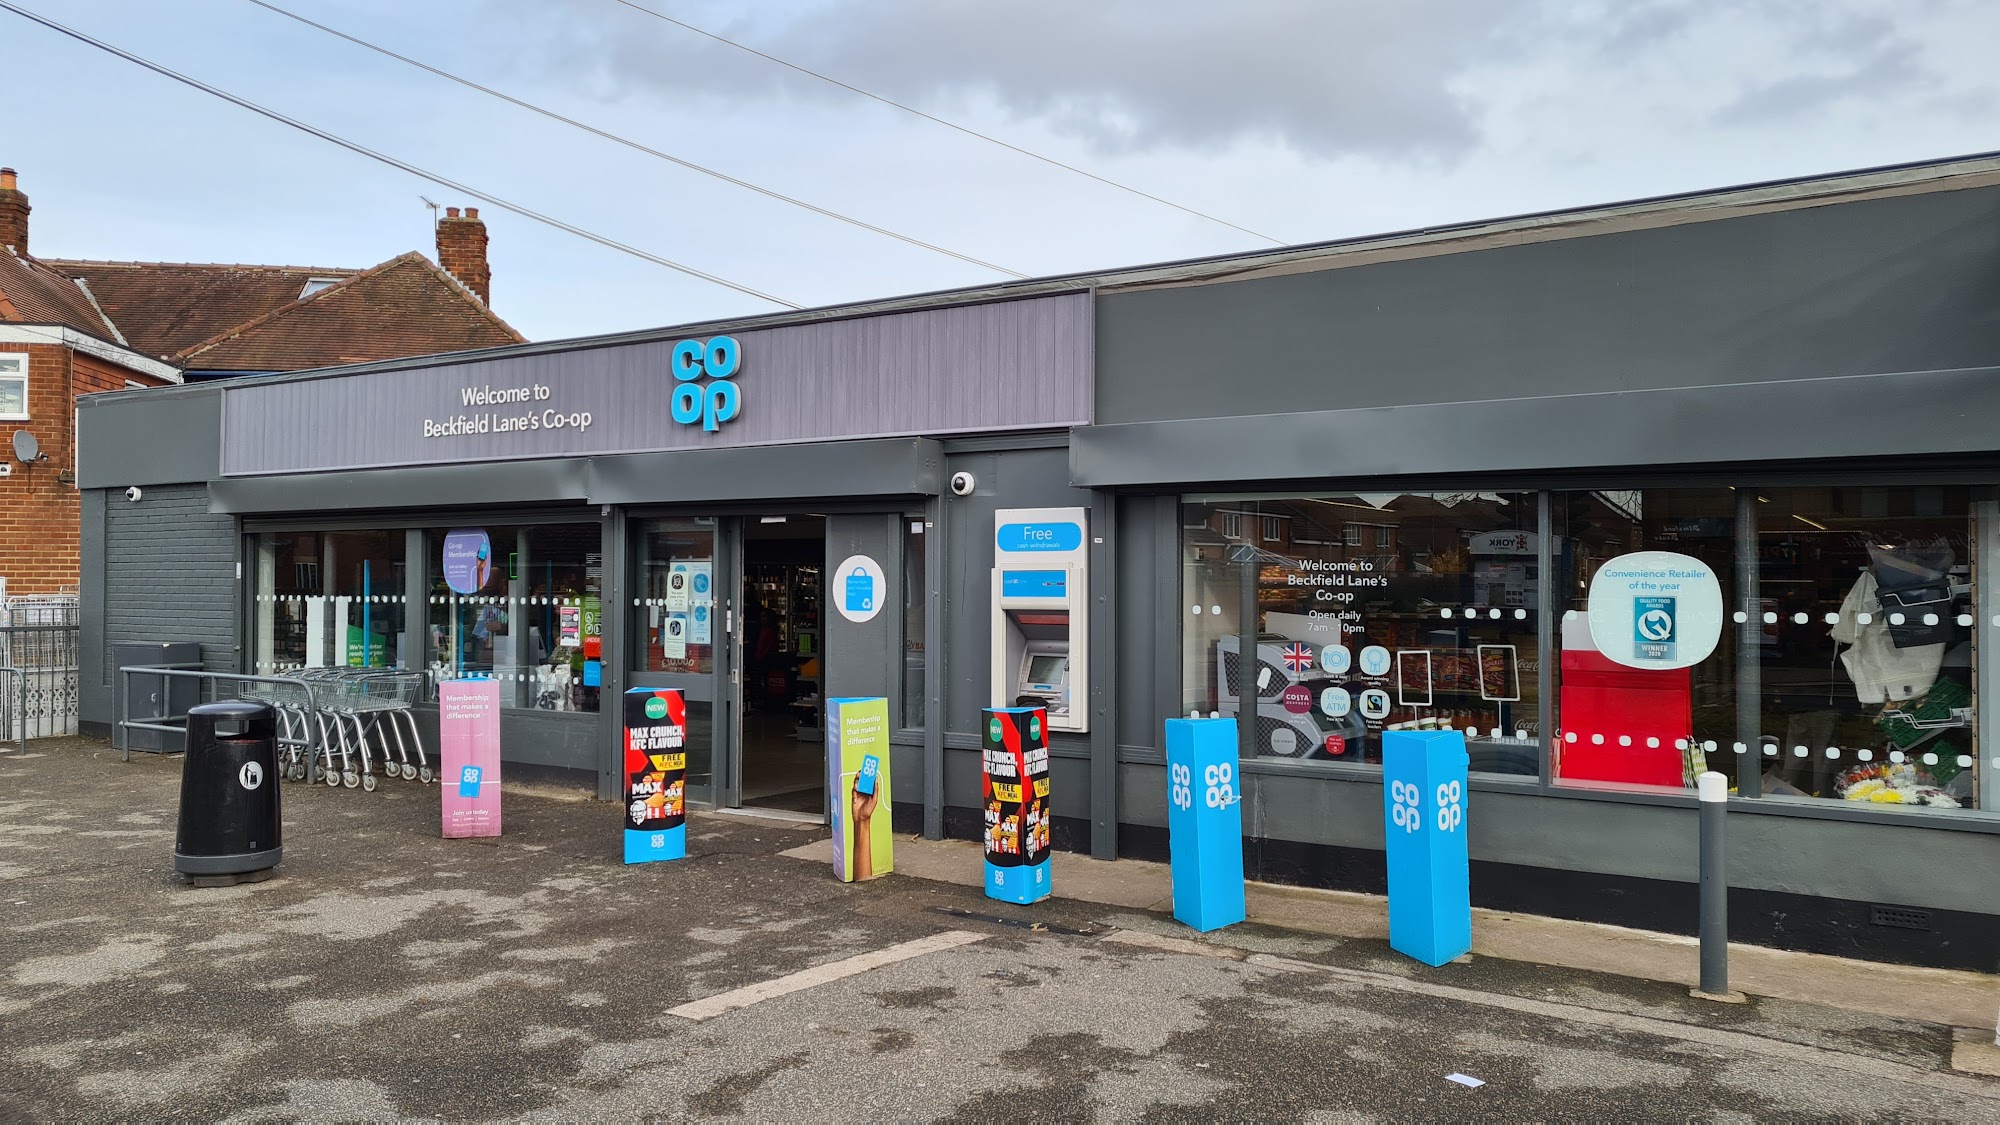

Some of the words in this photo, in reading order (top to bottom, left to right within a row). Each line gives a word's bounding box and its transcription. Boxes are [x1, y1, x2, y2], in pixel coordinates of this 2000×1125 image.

[461, 385, 530, 406] Welcome
[534, 384, 550, 400] to
[424, 413, 488, 437] Beckfield
[493, 411, 539, 432] Lane's
[542, 409, 592, 432] Co-op
[1024, 526, 1053, 540] Free
[1299, 559, 1357, 571] Welcome
[1360, 561, 1373, 571] to
[1604, 569, 1666, 578] Convenience
[1669, 569, 1706, 578] Retailer
[1288, 574, 1344, 586] Beckfield
[1348, 574, 1388, 586] Lane's
[1629, 581, 1638, 589] of
[1641, 581, 1656, 590] the
[1660, 583, 1680, 591] year
[1316, 589, 1354, 604] Co-op
[1308, 609, 1335, 621] Open
[1338, 610, 1361, 622] daily
[1307, 622, 1328, 632] 7am
[1337, 623, 1365, 634] 10pm
[446, 694, 489, 702] Membership
[1327, 692, 1345, 701] Free
[461, 703, 483, 711] makes
[647, 704, 665, 712] NEW
[1326, 702, 1346, 711] ATM
[846, 715, 881, 726] Membership
[630, 727, 649, 739] MAX
[650, 725, 685, 738] CRUNCH,
[860, 726, 876, 734] makes
[990, 726, 1001, 734] NEW
[1030, 725, 1039, 733] NEW
[630, 738, 647, 750] KFC
[648, 737, 682, 749] FLAVOUR
[847, 737, 875, 746] difference
[662, 753, 681, 761] FREE
[991, 762, 1016, 777] FLAVOUR
[632, 781, 662, 795] MAX
[998, 783, 1015, 792] FREE
[1038, 778, 1048, 788] FREE
[664, 787, 683, 797] MAX
[984, 809, 1000, 825] MAX
[1026, 810, 1040, 826] MAX
[1001, 821, 1017, 832] MAX
